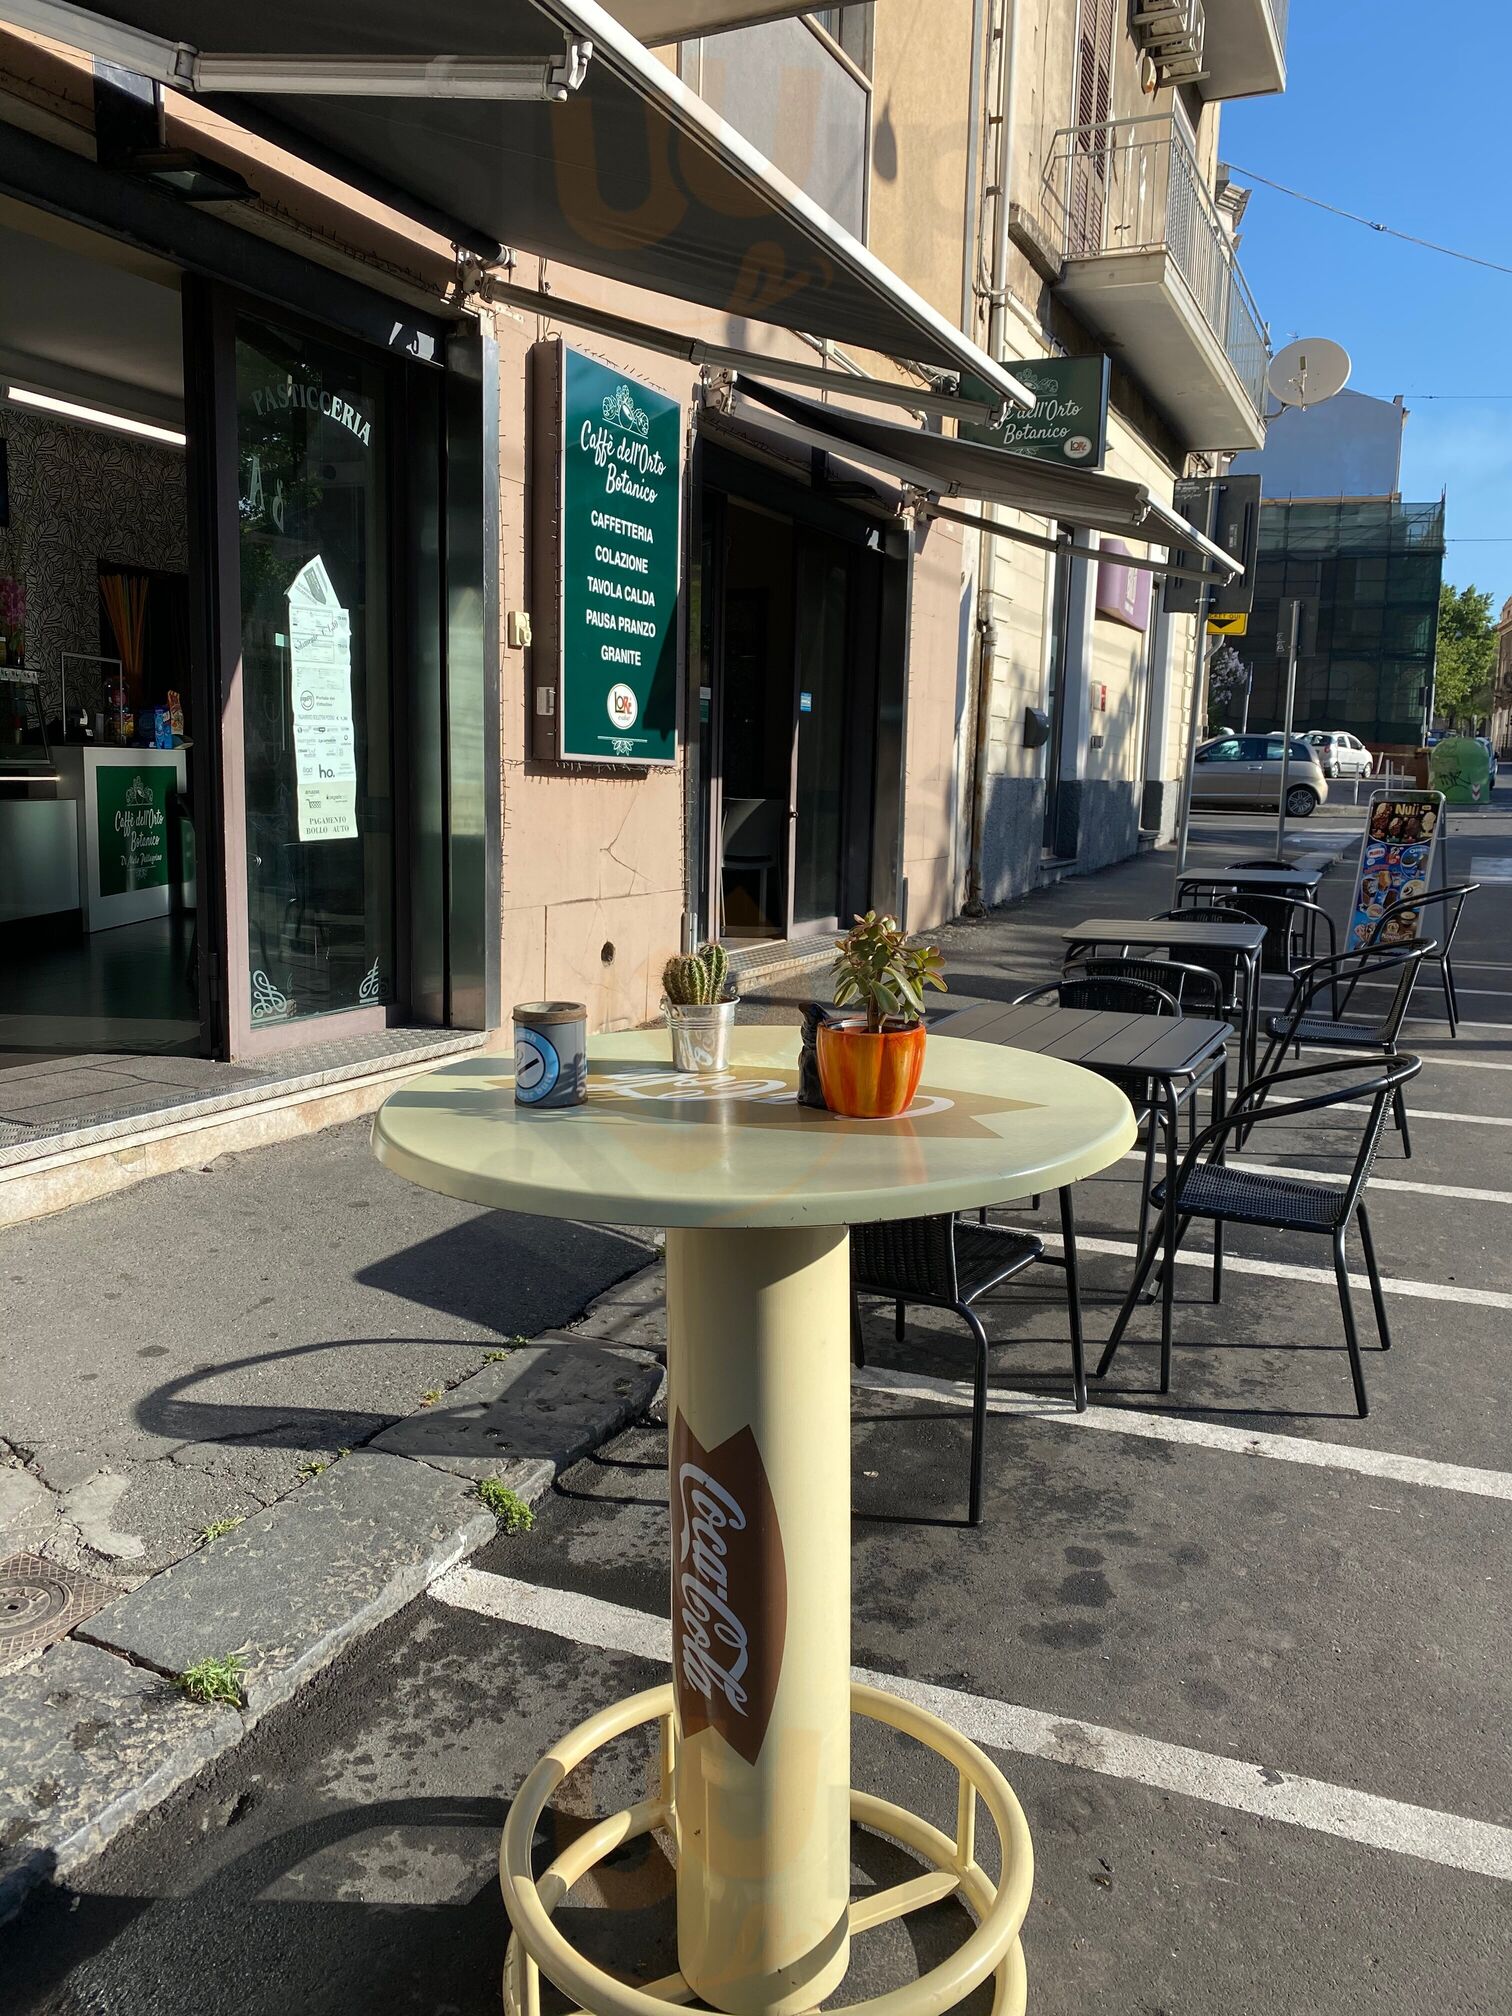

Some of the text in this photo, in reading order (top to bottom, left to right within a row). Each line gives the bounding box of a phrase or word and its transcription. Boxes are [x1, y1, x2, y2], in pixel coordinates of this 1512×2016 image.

[252, 383, 372, 447] PASTICCERIA
[580, 419, 667, 476] Caffè dell'Orto
[1003, 422, 1071, 445] Botanico
[605, 462, 658, 504] Botanico
[590, 509, 654, 544] CAFFETTERIA
[594, 544, 649, 574] COLAZIONE
[586, 575, 656, 607] TAVOLA CALDA
[585, 608, 656, 638] PAUSA PRANZO
[600, 644, 642, 667] GRANITE
[306, 827, 328, 835] BOLLO
[309, 816, 346, 825] PAGAMENTO
[131, 830, 160, 852] Botanico
[679, 1461, 749, 1718] Coca-Cola
